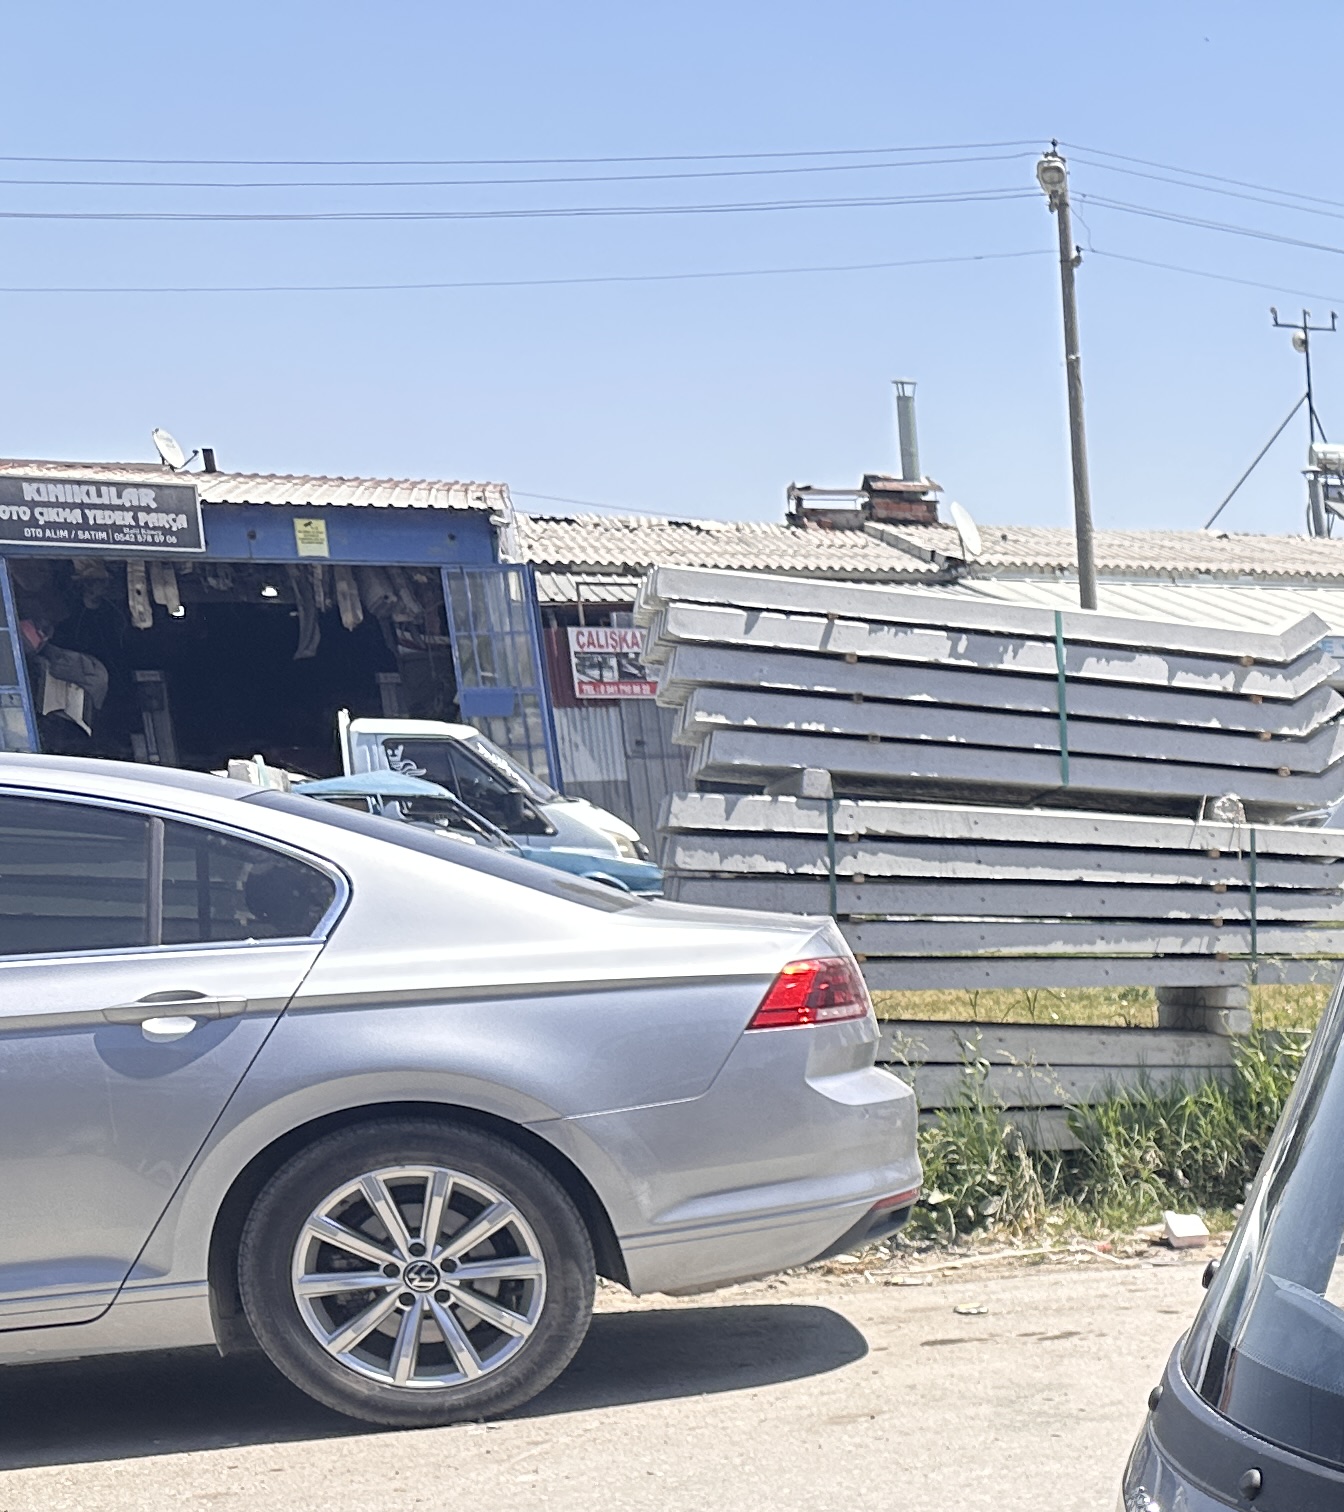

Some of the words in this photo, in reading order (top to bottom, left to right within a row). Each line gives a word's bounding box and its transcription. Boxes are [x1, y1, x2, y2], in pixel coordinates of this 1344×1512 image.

[22, 482, 158, 508] KINIKLILAR
[0, 504, 31, 521] OTO
[34, 507, 82, 525] ÇIKMA
[84, 508, 136, 526] YEDEK
[137, 511, 188, 532] PARÇA
[24, 527, 43, 538] OTO
[45, 528, 69, 539] ALIM
[77, 530, 108, 541] SATIM
